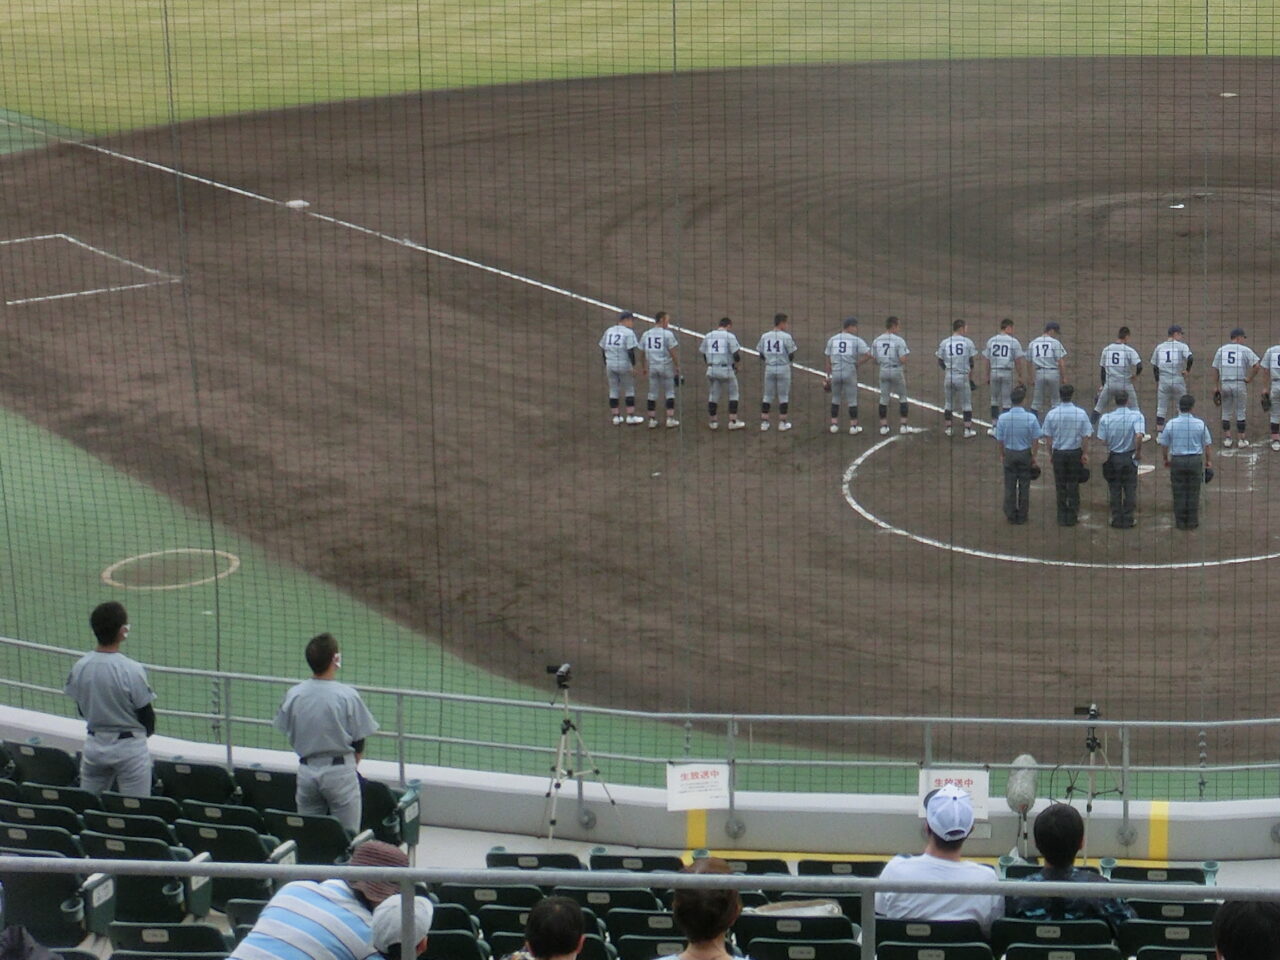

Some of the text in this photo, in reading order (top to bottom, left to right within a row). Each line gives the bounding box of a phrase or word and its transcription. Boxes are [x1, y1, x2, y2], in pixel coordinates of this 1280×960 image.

[608, 334, 621, 346] 12
[648, 337, 662, 349] 15
[712, 340, 719, 352] 4
[766, 340, 780, 352] 14
[838, 341, 847, 353] 9
[882, 344, 890, 356] 7
[949, 343, 964, 356] 16
[992, 344, 1008, 357] 20
[1035, 344, 1049, 357] 17
[1111, 352, 1120, 364] 6
[1165, 351, 1172, 363] 1
[1227, 351, 1236, 364] 5
[680, 769, 720, 781] 生放送中
